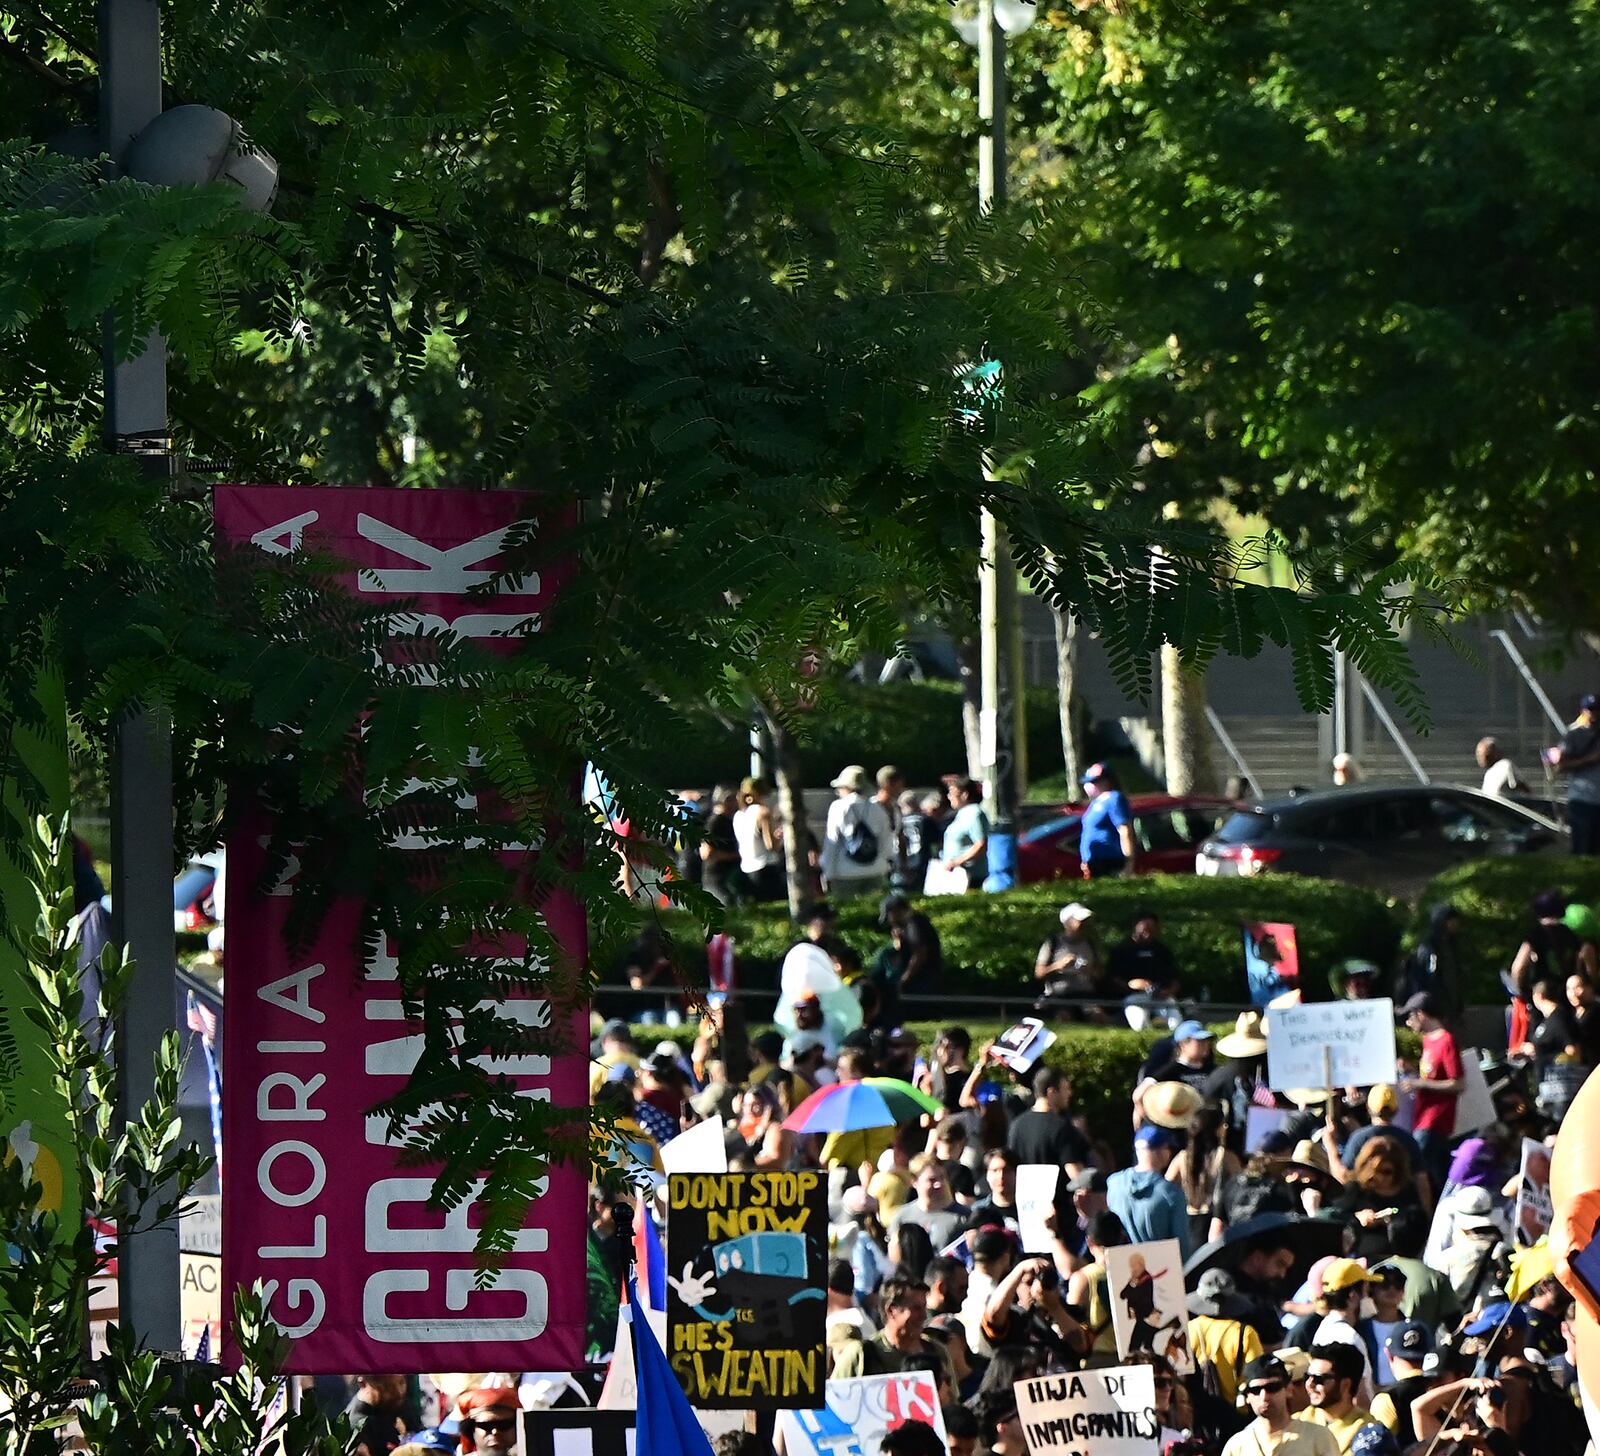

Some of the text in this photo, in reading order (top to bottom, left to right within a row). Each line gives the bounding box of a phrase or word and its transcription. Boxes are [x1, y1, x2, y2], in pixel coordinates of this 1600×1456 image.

[256, 962, 325, 1339] GLORIA
[670, 1172, 819, 1211] DONT STOP
[706, 1207, 811, 1241] NOW
[1028, 1376, 1087, 1403] HIJA
[1026, 1406, 1160, 1449] INMIGRANTES
